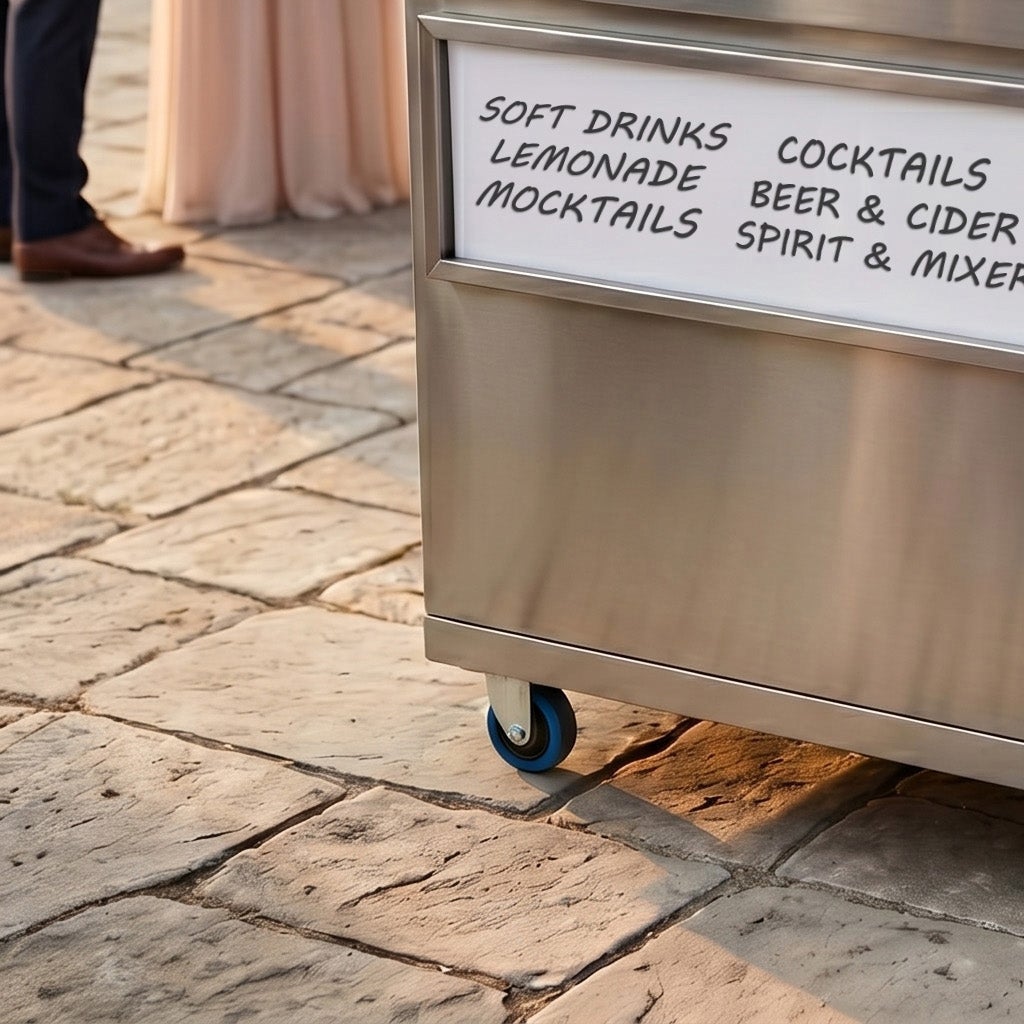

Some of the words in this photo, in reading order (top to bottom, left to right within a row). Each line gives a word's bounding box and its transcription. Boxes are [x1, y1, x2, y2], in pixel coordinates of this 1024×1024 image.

[478, 95, 577, 130] SOFT
[582, 109, 733, 151] DRINKS
[490, 138, 707, 192] LEMONADE
[777, 135, 992, 192] COCKTAILS
[475, 179, 703, 239] MOCKTAILS
[750, 179, 841, 219] BEER
[856, 194, 886, 226] &
[906, 202, 1020, 246] CIDER
[735, 220, 855, 263] SPIRIT
[863, 241, 892, 272] &
